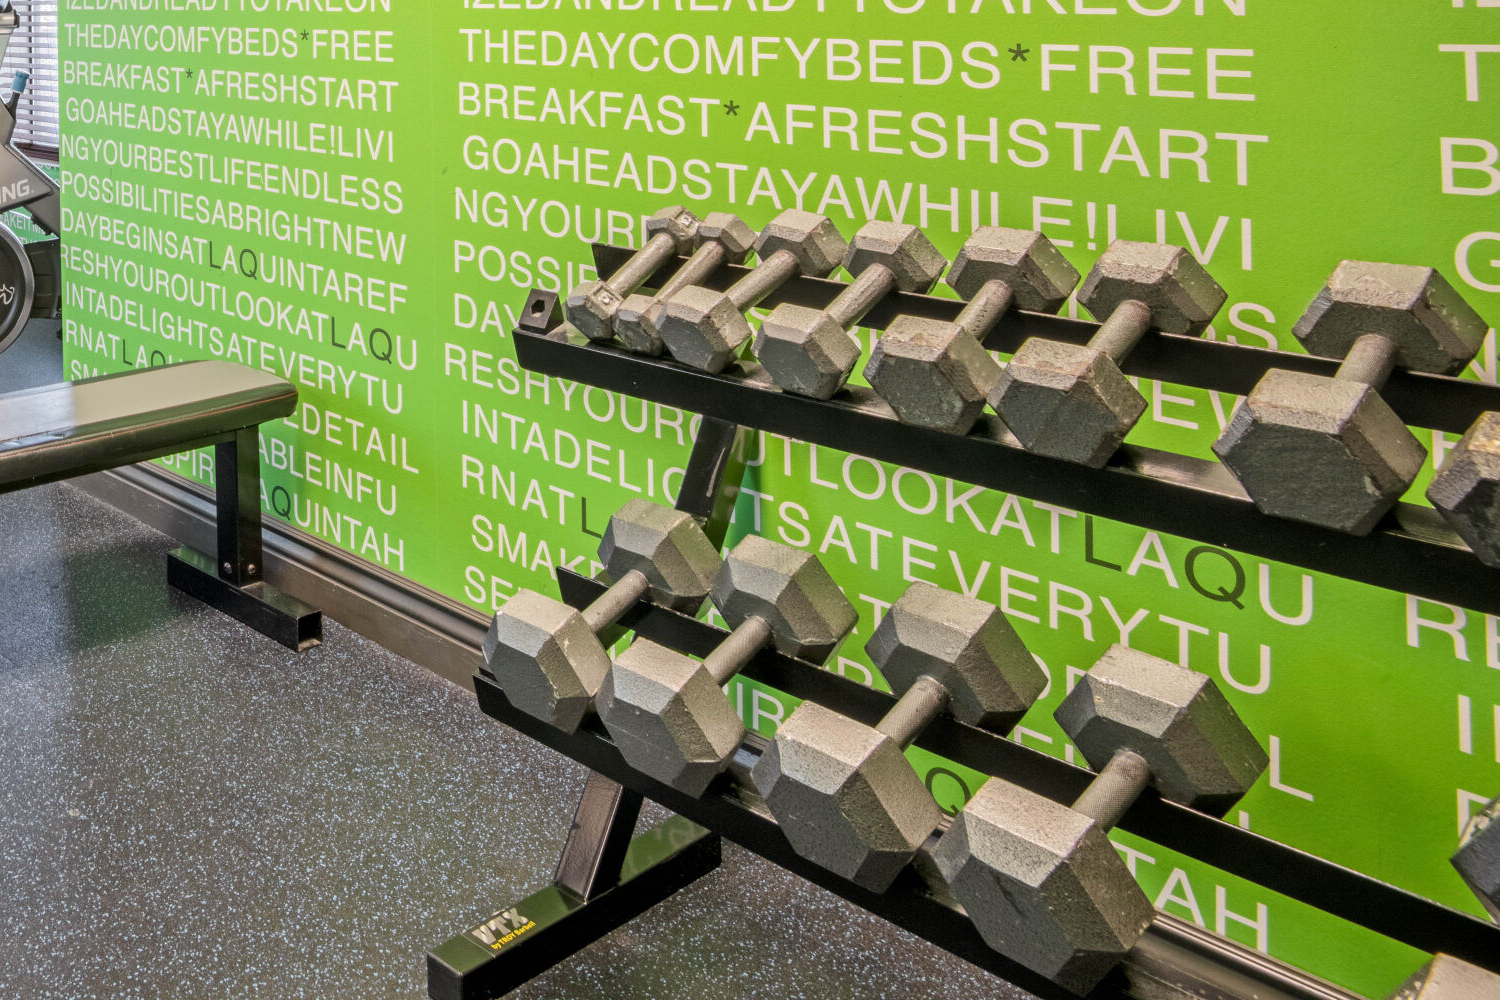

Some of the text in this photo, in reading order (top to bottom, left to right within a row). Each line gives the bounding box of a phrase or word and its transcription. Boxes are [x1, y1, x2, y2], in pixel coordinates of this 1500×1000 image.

[61, 133, 404, 215] NGYOURBESTLIFEENDLESS
[66, 97, 394, 163] GOAHEADSTAYAWHILE!LIVI
[61, 170, 407, 265] POSSIBILITIESABRIGHTNEW
[61, 207, 409, 315] DAYBEGINSATLAQUINTAREF
[60, 243, 418, 371] RESHYOUROUTLOOKATLAQU
[66, 282, 403, 415] INTADELIGHTSATEVERYTU
[471, 907, 528, 945] VTX
